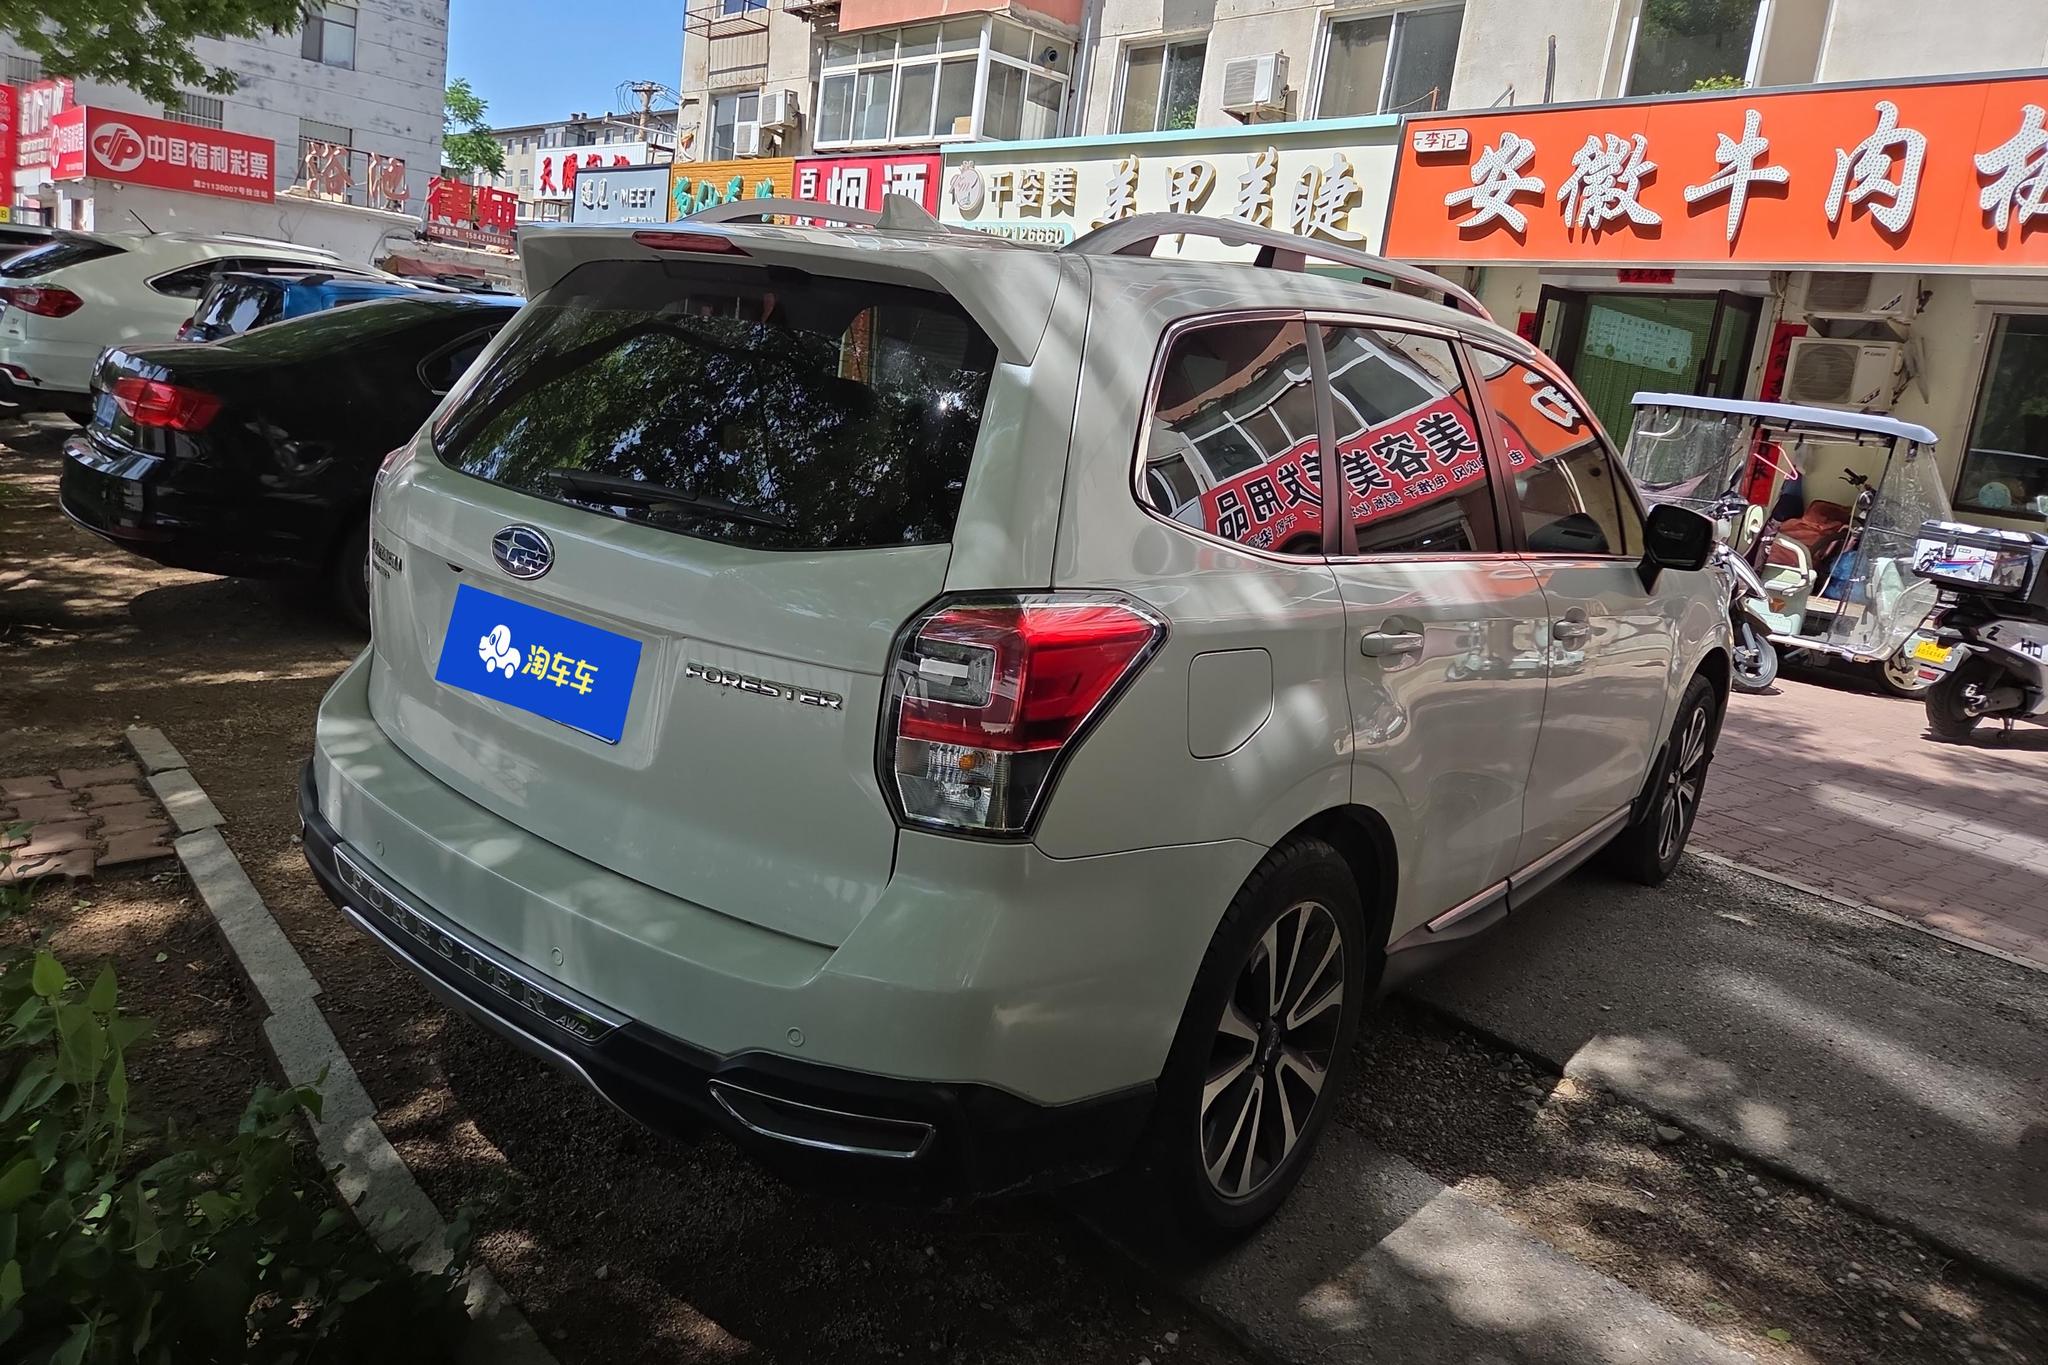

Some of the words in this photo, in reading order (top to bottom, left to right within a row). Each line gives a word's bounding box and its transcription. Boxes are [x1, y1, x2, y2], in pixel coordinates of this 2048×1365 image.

[147, 135, 268, 180] 中国福利彩票
[1424, 132, 1456, 149] 李记
[620, 187, 656, 208] MEET
[827, 164, 928, 226] 烟酒
[988, 167, 1077, 212] 千姿美
[685, 662, 843, 710] FORESTER
[350, 869, 548, 1016] FORESTER
[555, 1015, 589, 1036] AWD
